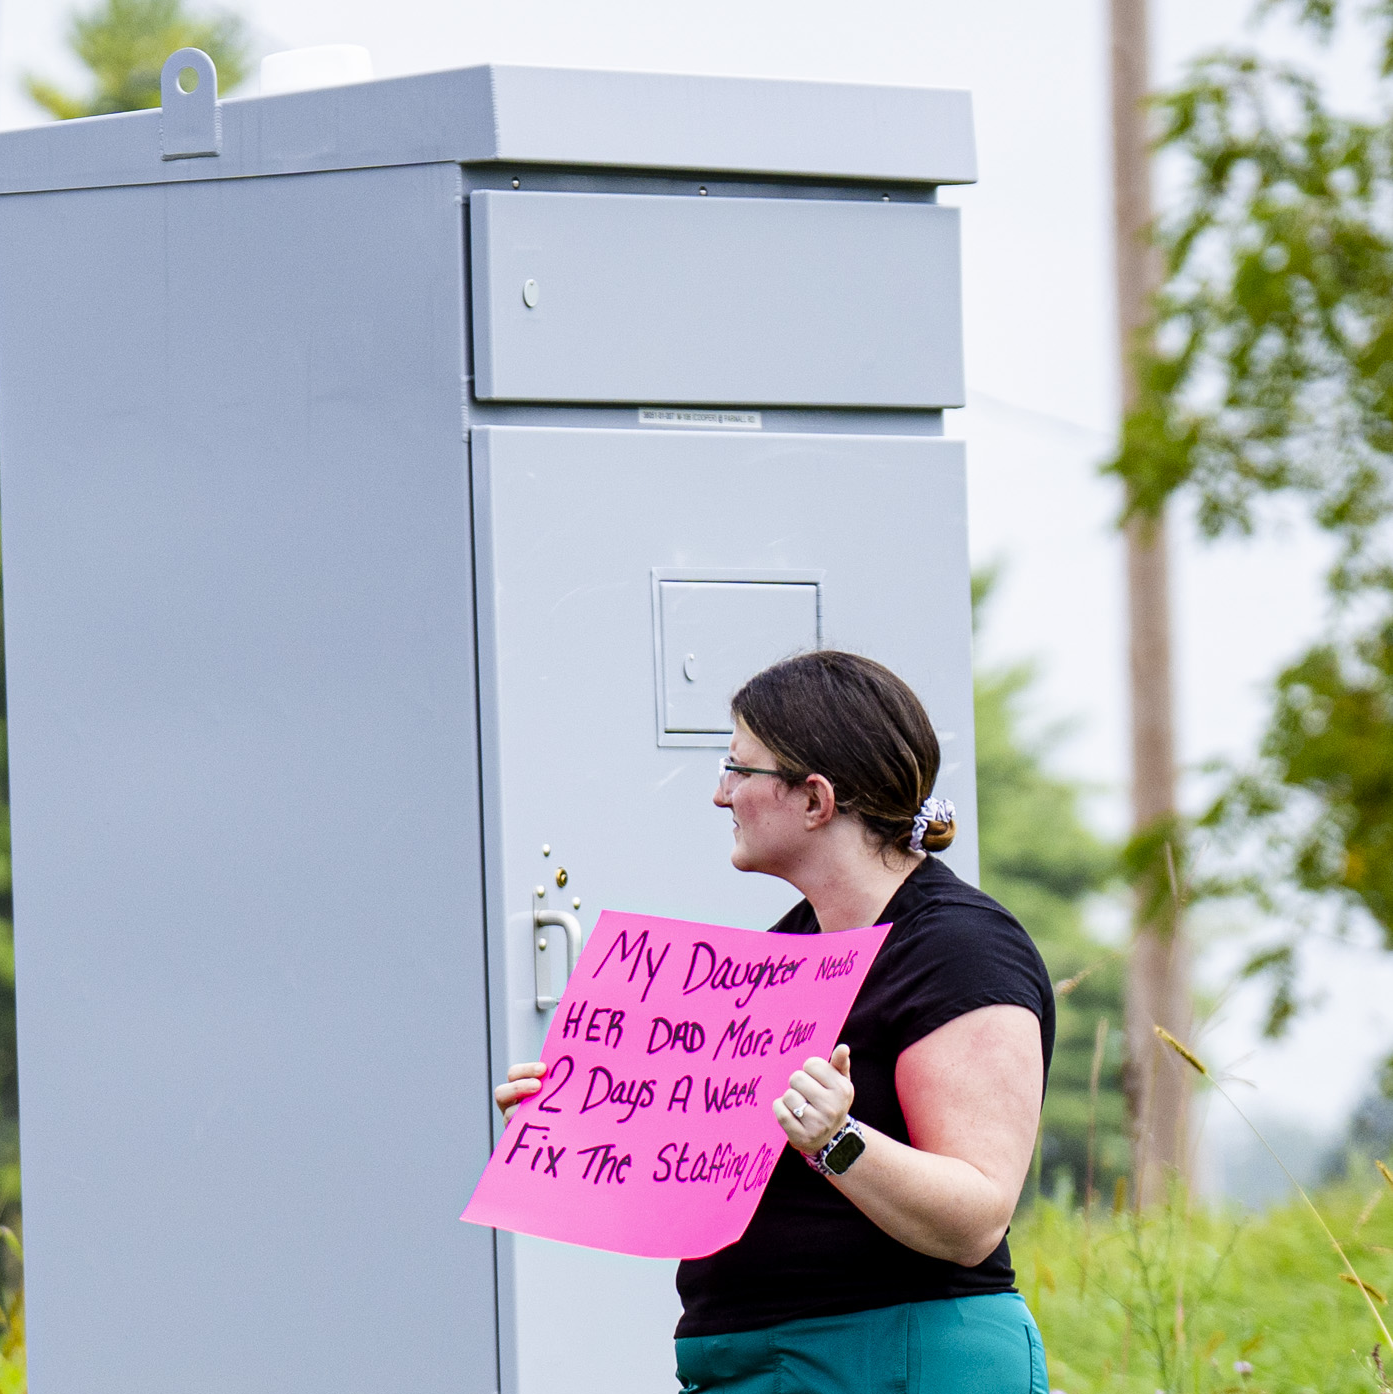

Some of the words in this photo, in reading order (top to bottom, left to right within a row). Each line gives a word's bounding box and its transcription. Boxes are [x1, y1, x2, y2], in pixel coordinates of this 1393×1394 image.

[593, 930, 671, 1002] My
[683, 941, 808, 1008] Daughter
[563, 1000, 625, 1048] HER
[647, 1016, 705, 1054] DAD
[713, 1014, 773, 1061] More
[780, 1019, 816, 1055] than
[538, 1055, 574, 1112] 2
[580, 1066, 657, 1123] Days
[668, 1075, 692, 1112] A
[505, 1123, 566, 1177] Fix
[577, 1144, 632, 1184] The
[653, 1142, 749, 1201] Staffing
